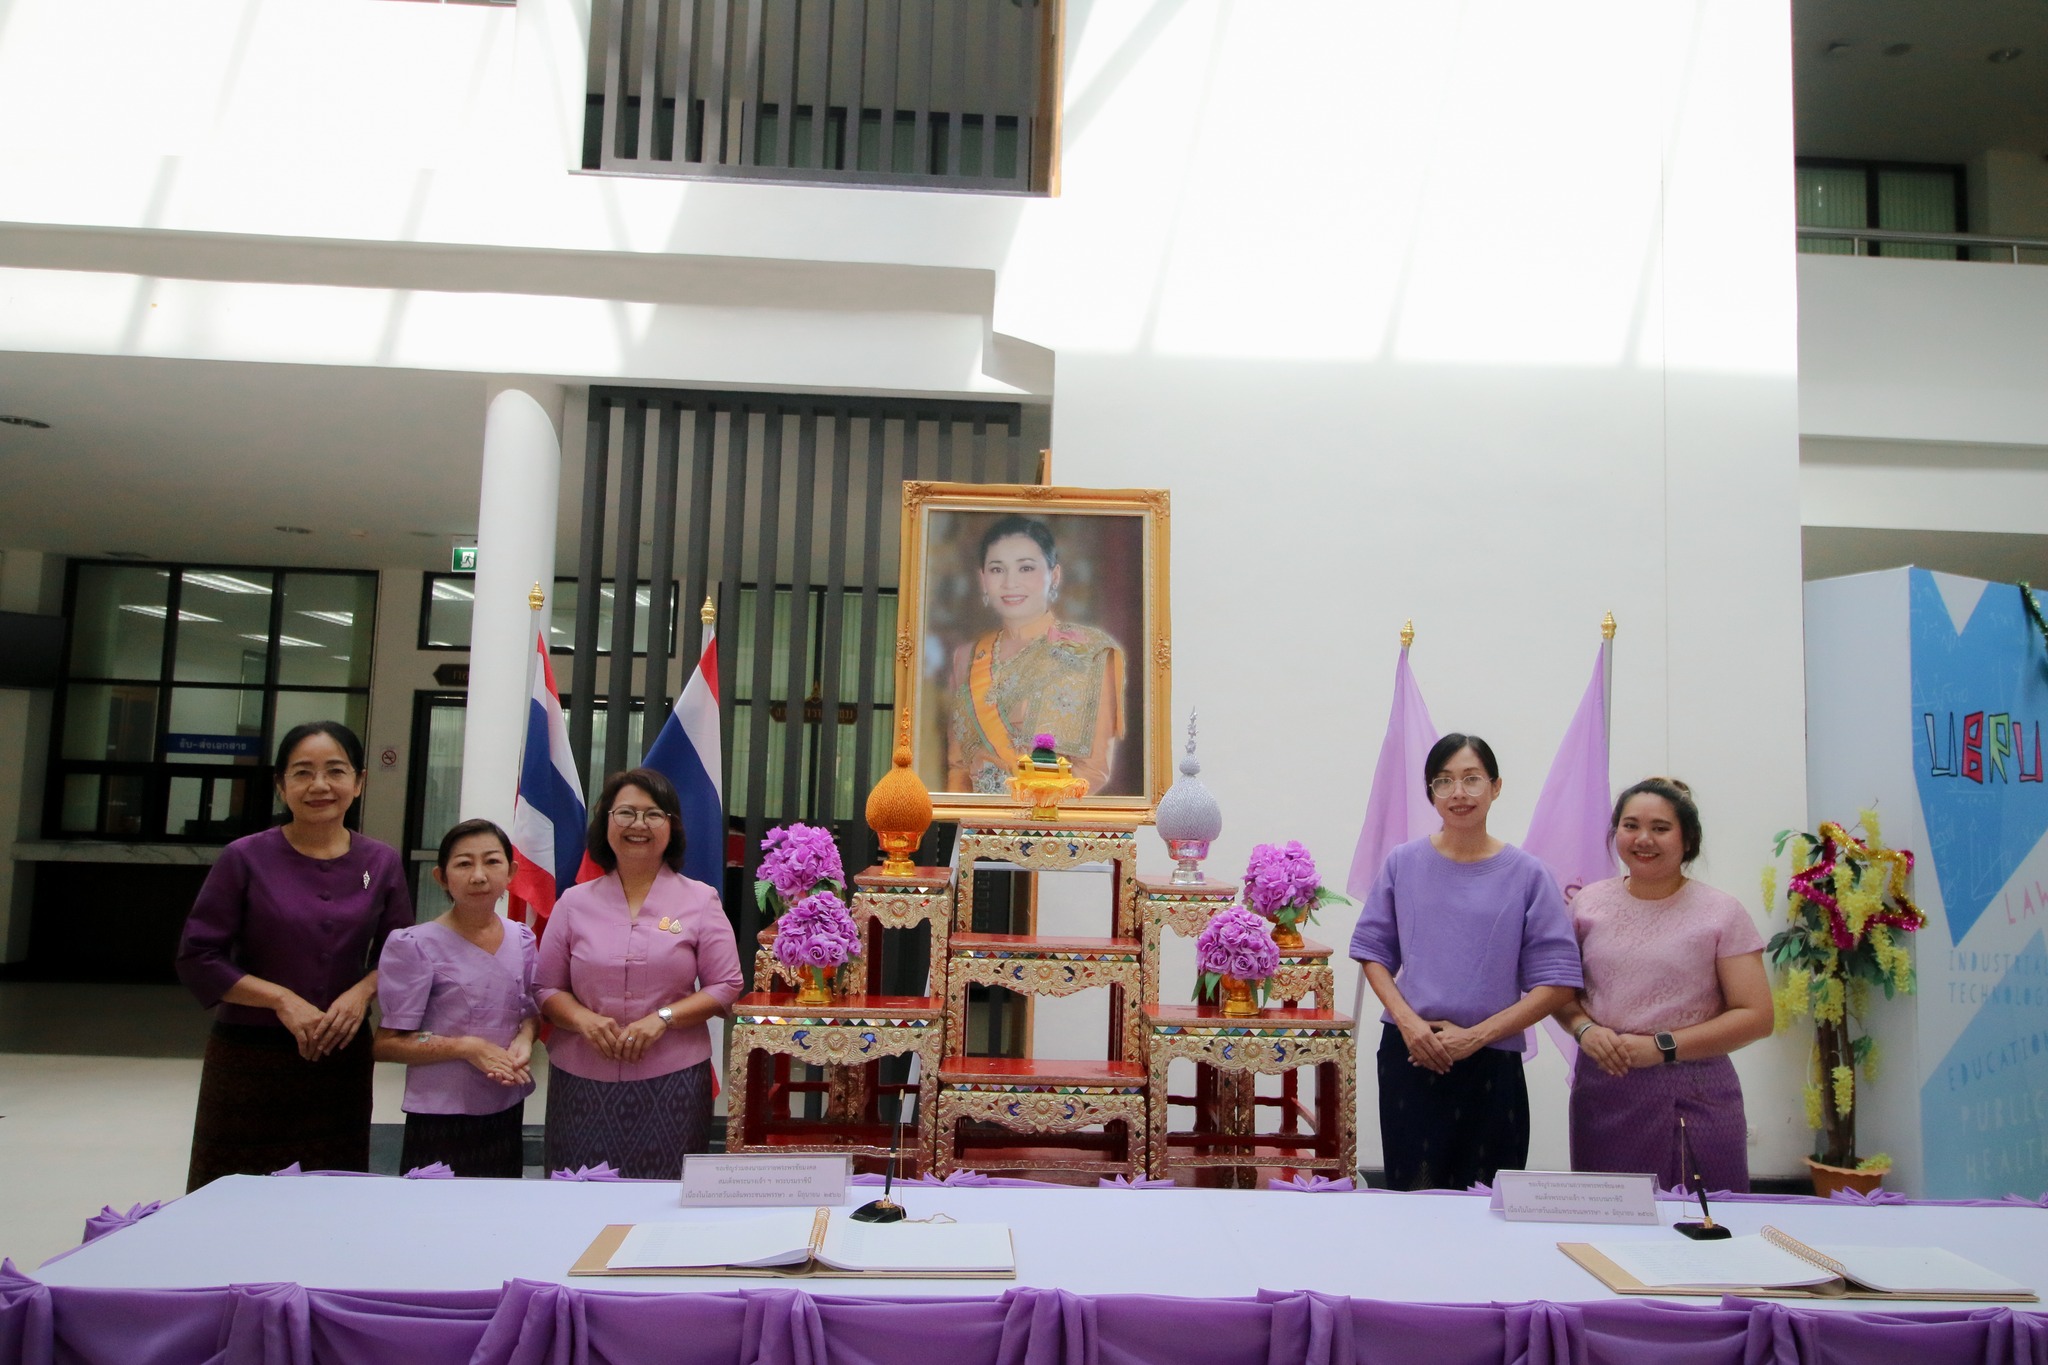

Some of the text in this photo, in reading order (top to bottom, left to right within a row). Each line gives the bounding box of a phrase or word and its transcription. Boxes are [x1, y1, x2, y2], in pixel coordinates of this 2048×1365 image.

[179, 738, 247, 751] รับ-ส่งเอกสาร
[1924, 711, 2043, 784] UBRU
[1948, 982, 2048, 1007] TECHNOLOG
[1960, 1087, 2046, 1136] PUBLIC
